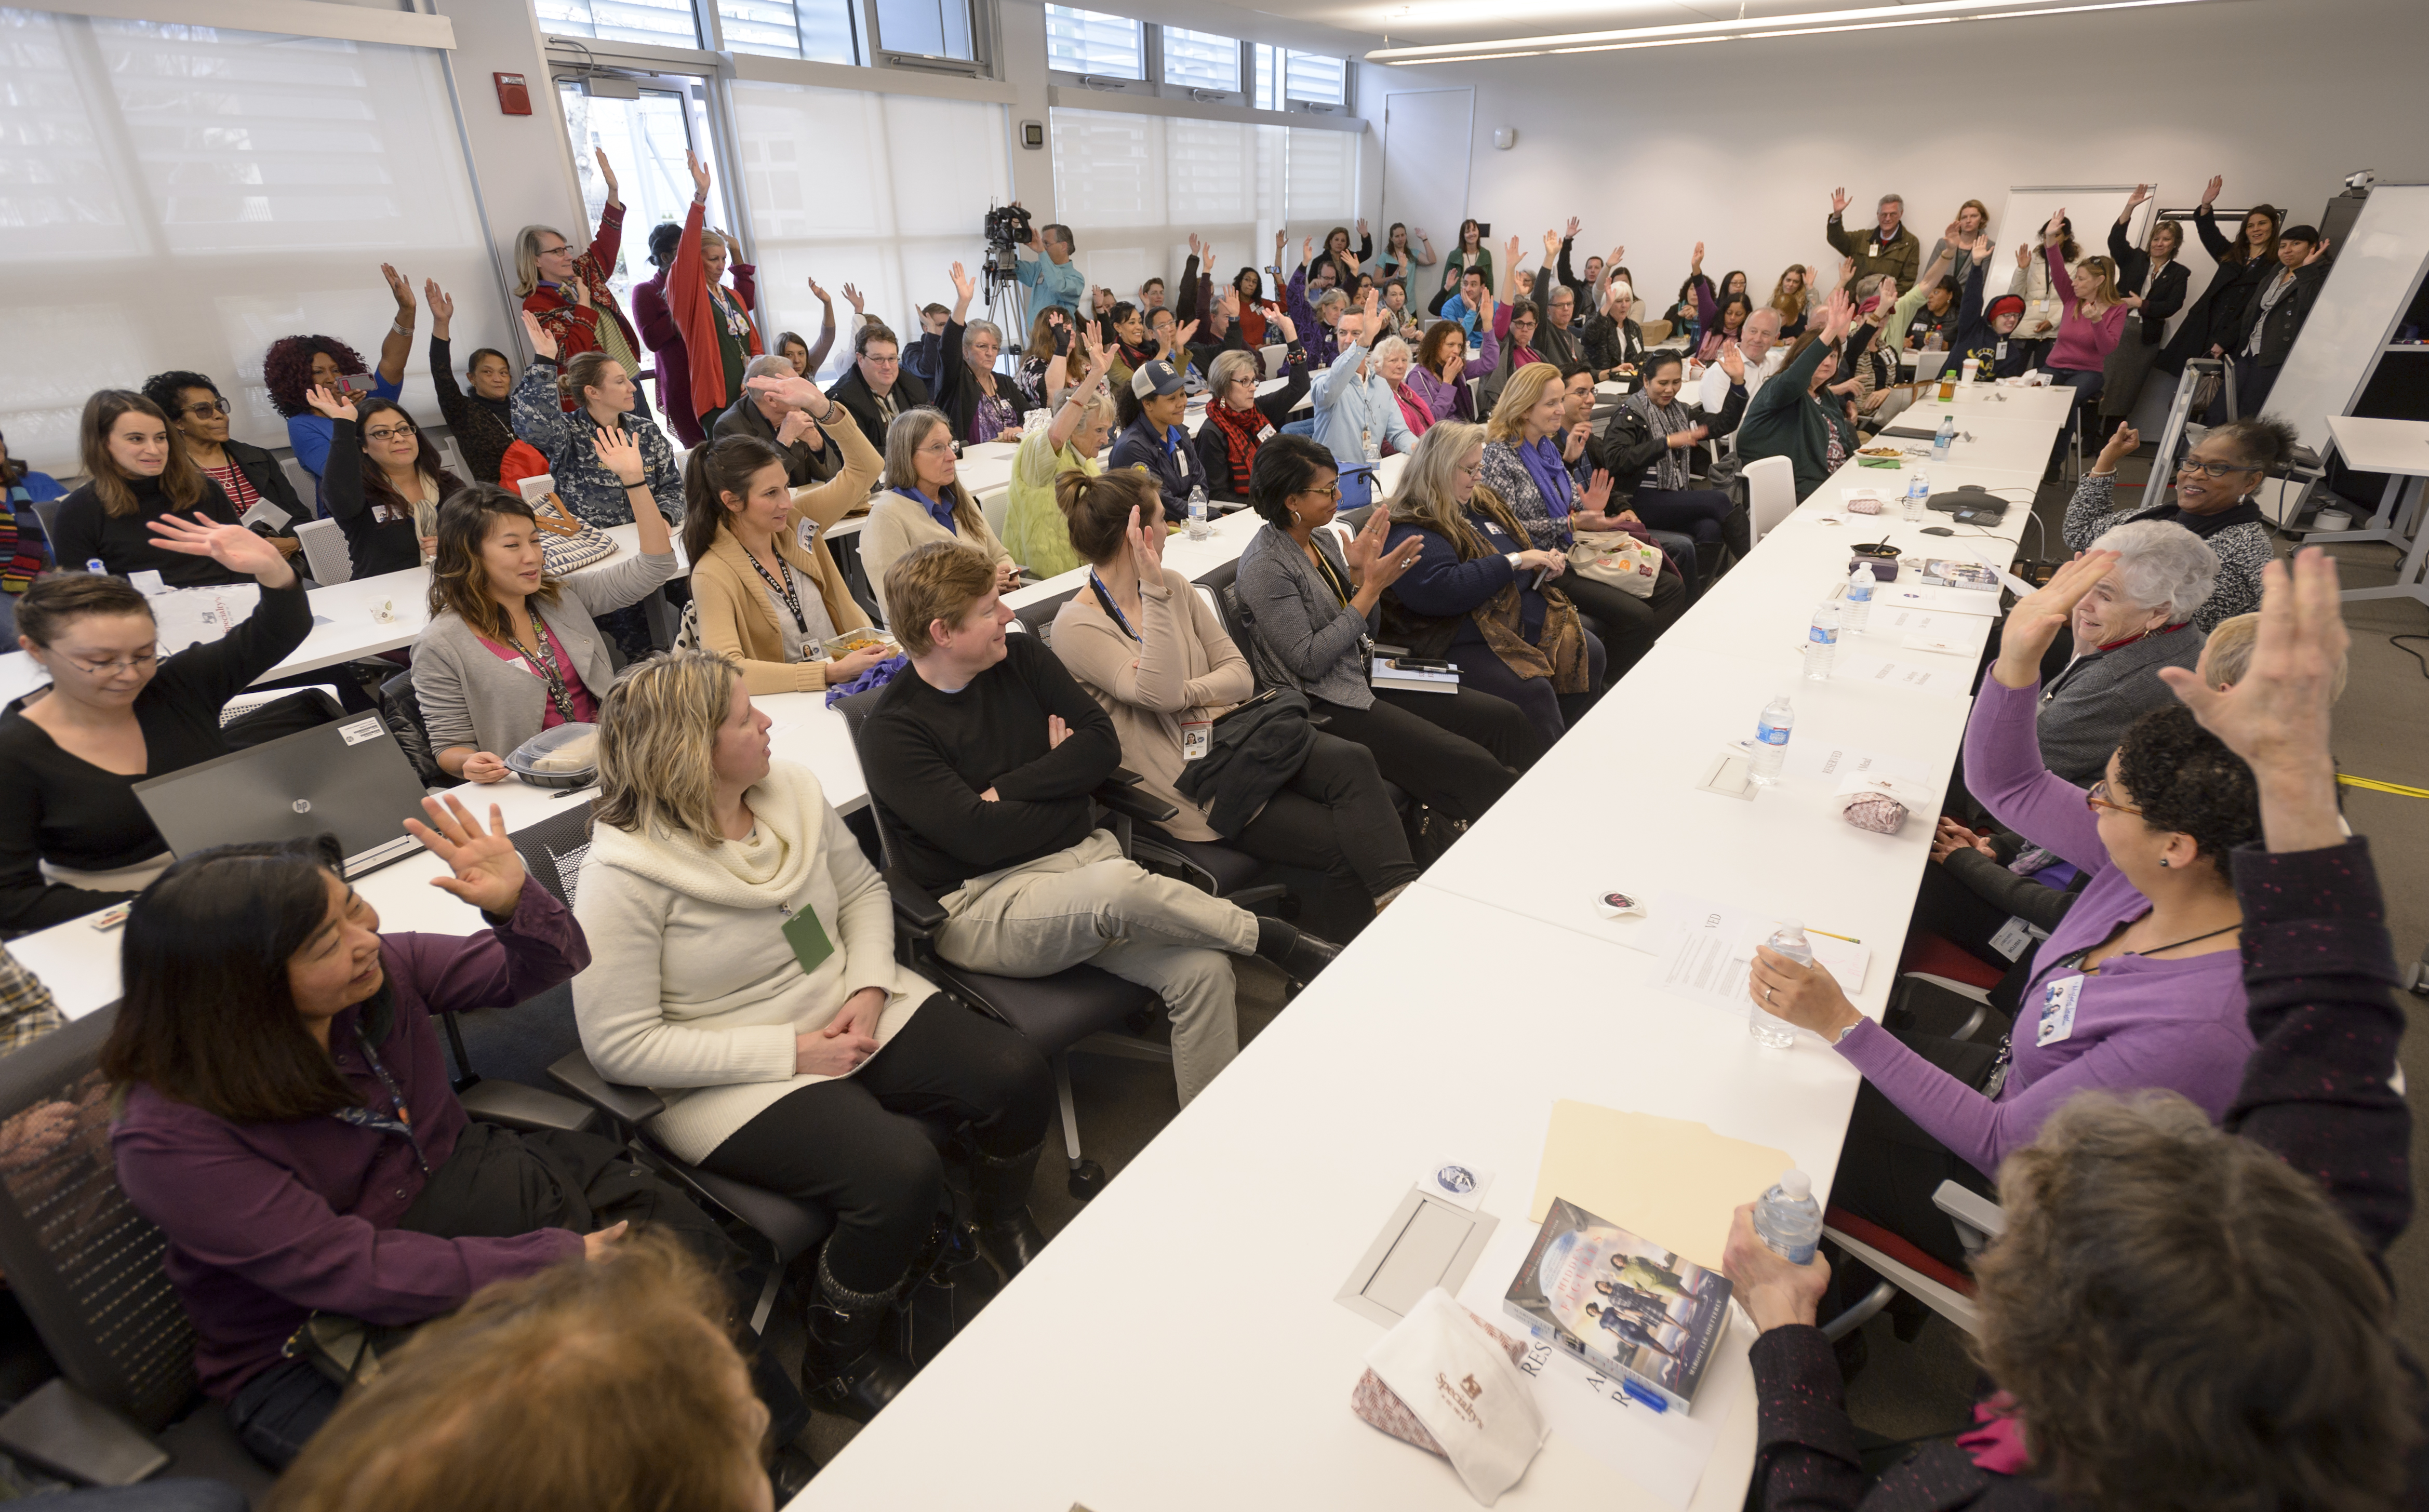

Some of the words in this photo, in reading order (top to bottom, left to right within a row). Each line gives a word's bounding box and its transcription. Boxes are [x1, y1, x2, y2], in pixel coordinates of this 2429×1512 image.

[767, 576, 781, 590] NASA
[782, 566, 791, 582] NASA
[786, 598, 798, 613] NASA
[791, 594, 799, 609] NASA
[1822, 751, 1843, 774] RESERVED
[1558, 1246, 1583, 1291] HIDDEN
[1561, 1235, 1603, 1311] FIGURES
[1689, 1349, 1703, 1375] MARGOT
[1706, 1299, 1722, 1336] SHETTERLY
[1435, 1373, 1484, 1430] Specialty's
